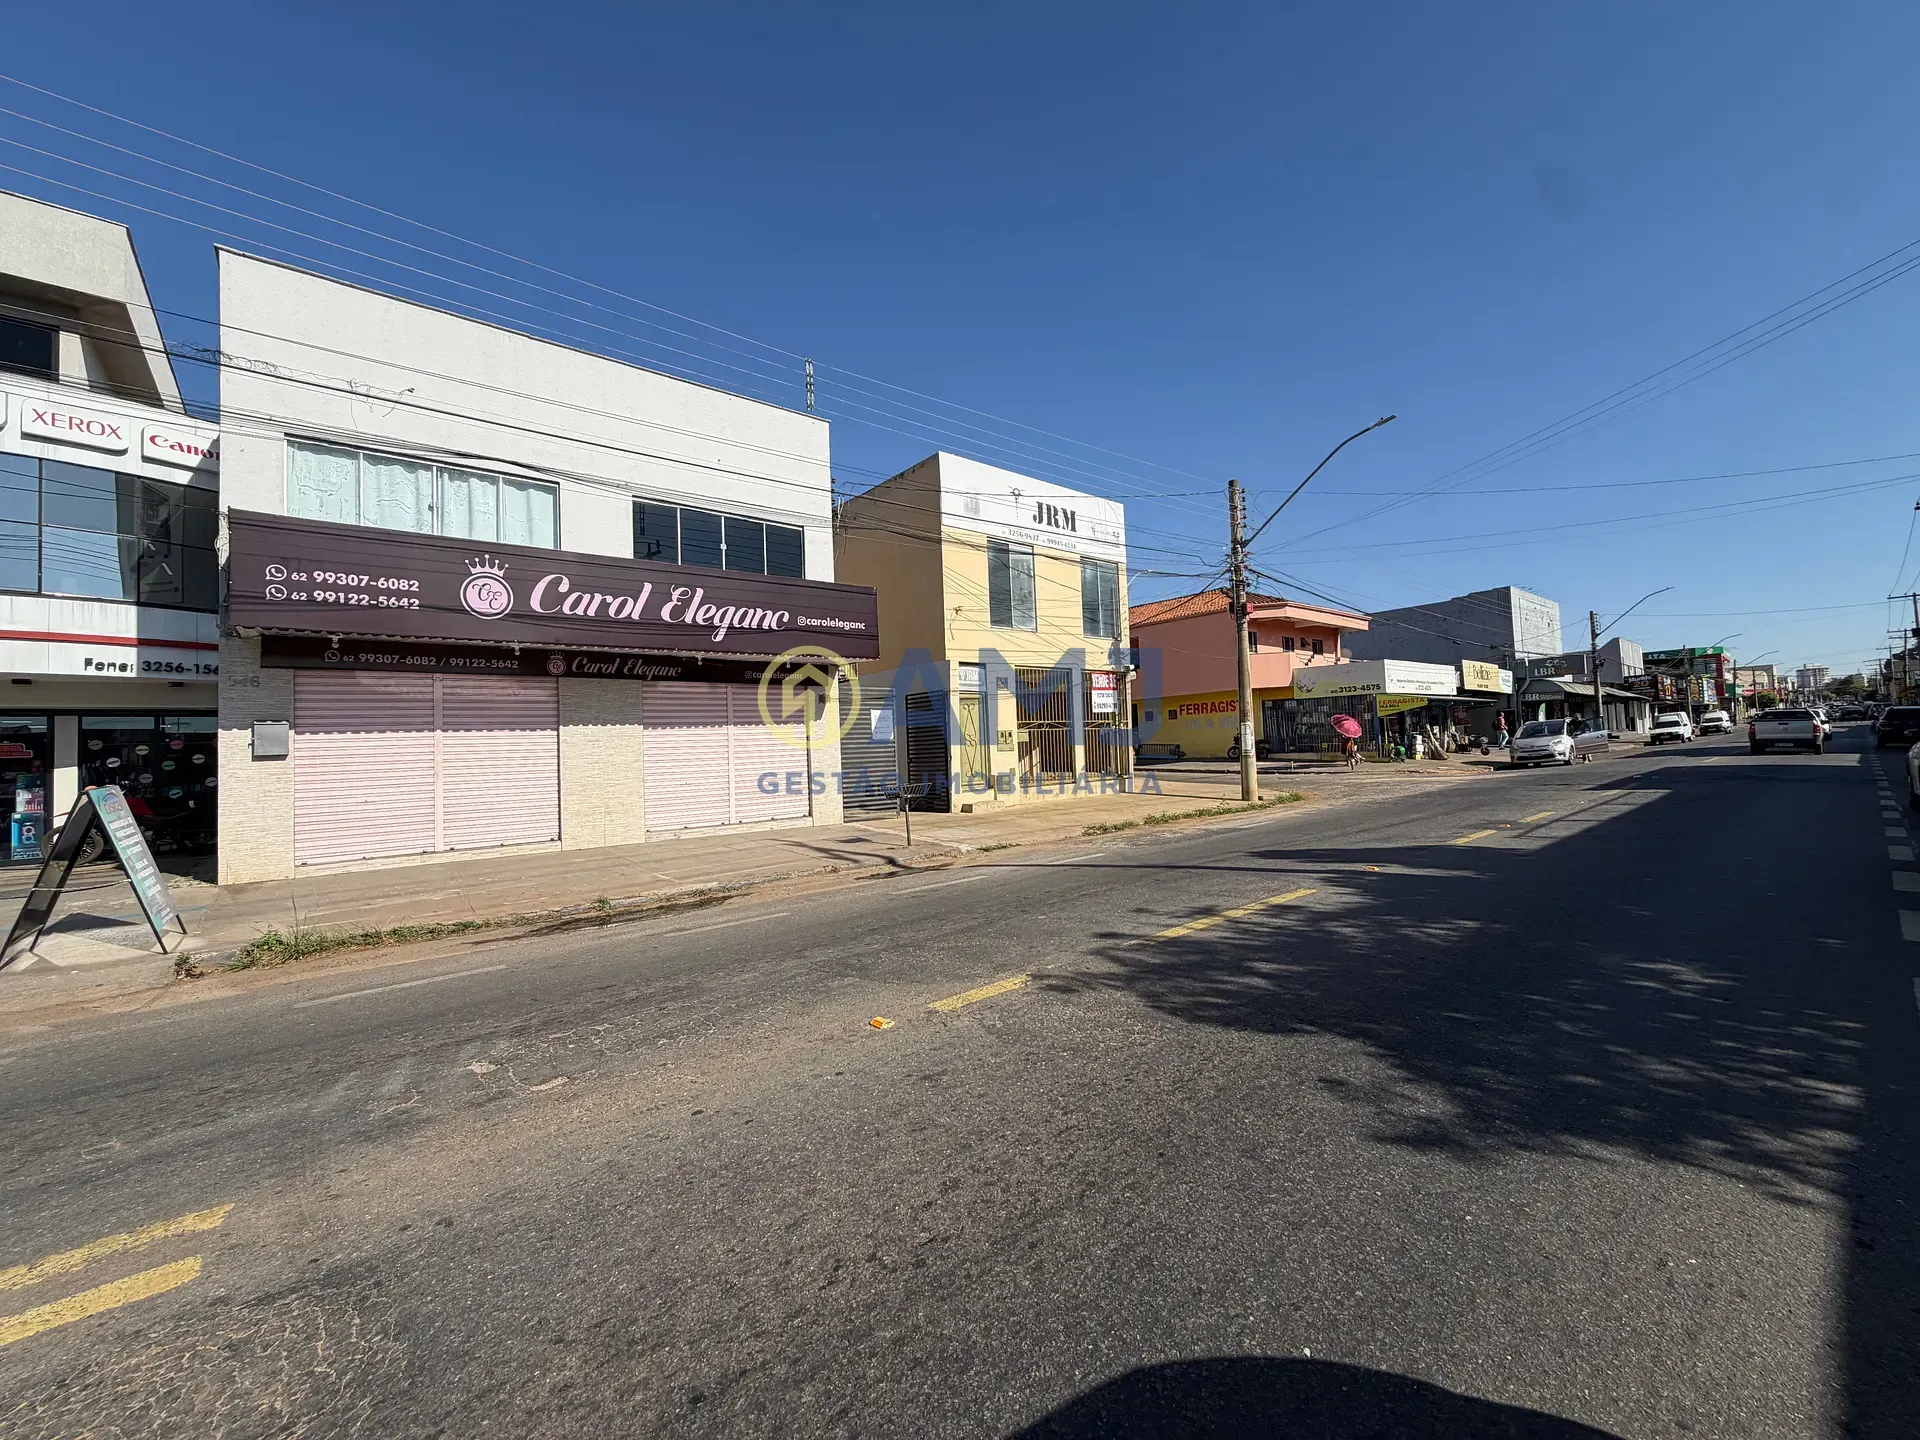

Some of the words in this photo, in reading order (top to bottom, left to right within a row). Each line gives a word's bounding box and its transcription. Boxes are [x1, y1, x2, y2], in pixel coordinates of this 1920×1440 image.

[31, 408, 123, 440] XEROX
[1032, 501, 1077, 532] JRM
[291, 571, 307, 581] 62
[313, 570, 419, 592] 99307-6082
[291, 591, 307, 601] 62
[313, 590, 420, 610] 99122-5642
[530, 574, 653, 620] Carol
[660, 584, 790, 642] Eleganc
[141, 660, 219, 675] 3256-156
[343, 654, 355, 662] 62
[358, 653, 437, 666] 99307-6082
[449, 657, 519, 669] 99122-5642
[571, 656, 620, 674] Carol
[623, 658, 681, 680] Eleganc
[1534, 667, 1556, 676] LBR
[1338, 684, 1381, 693] 3123-4575
[1179, 699, 1238, 716] FERRAGIS
[1378, 697, 1425, 707] FERRAGISTA
